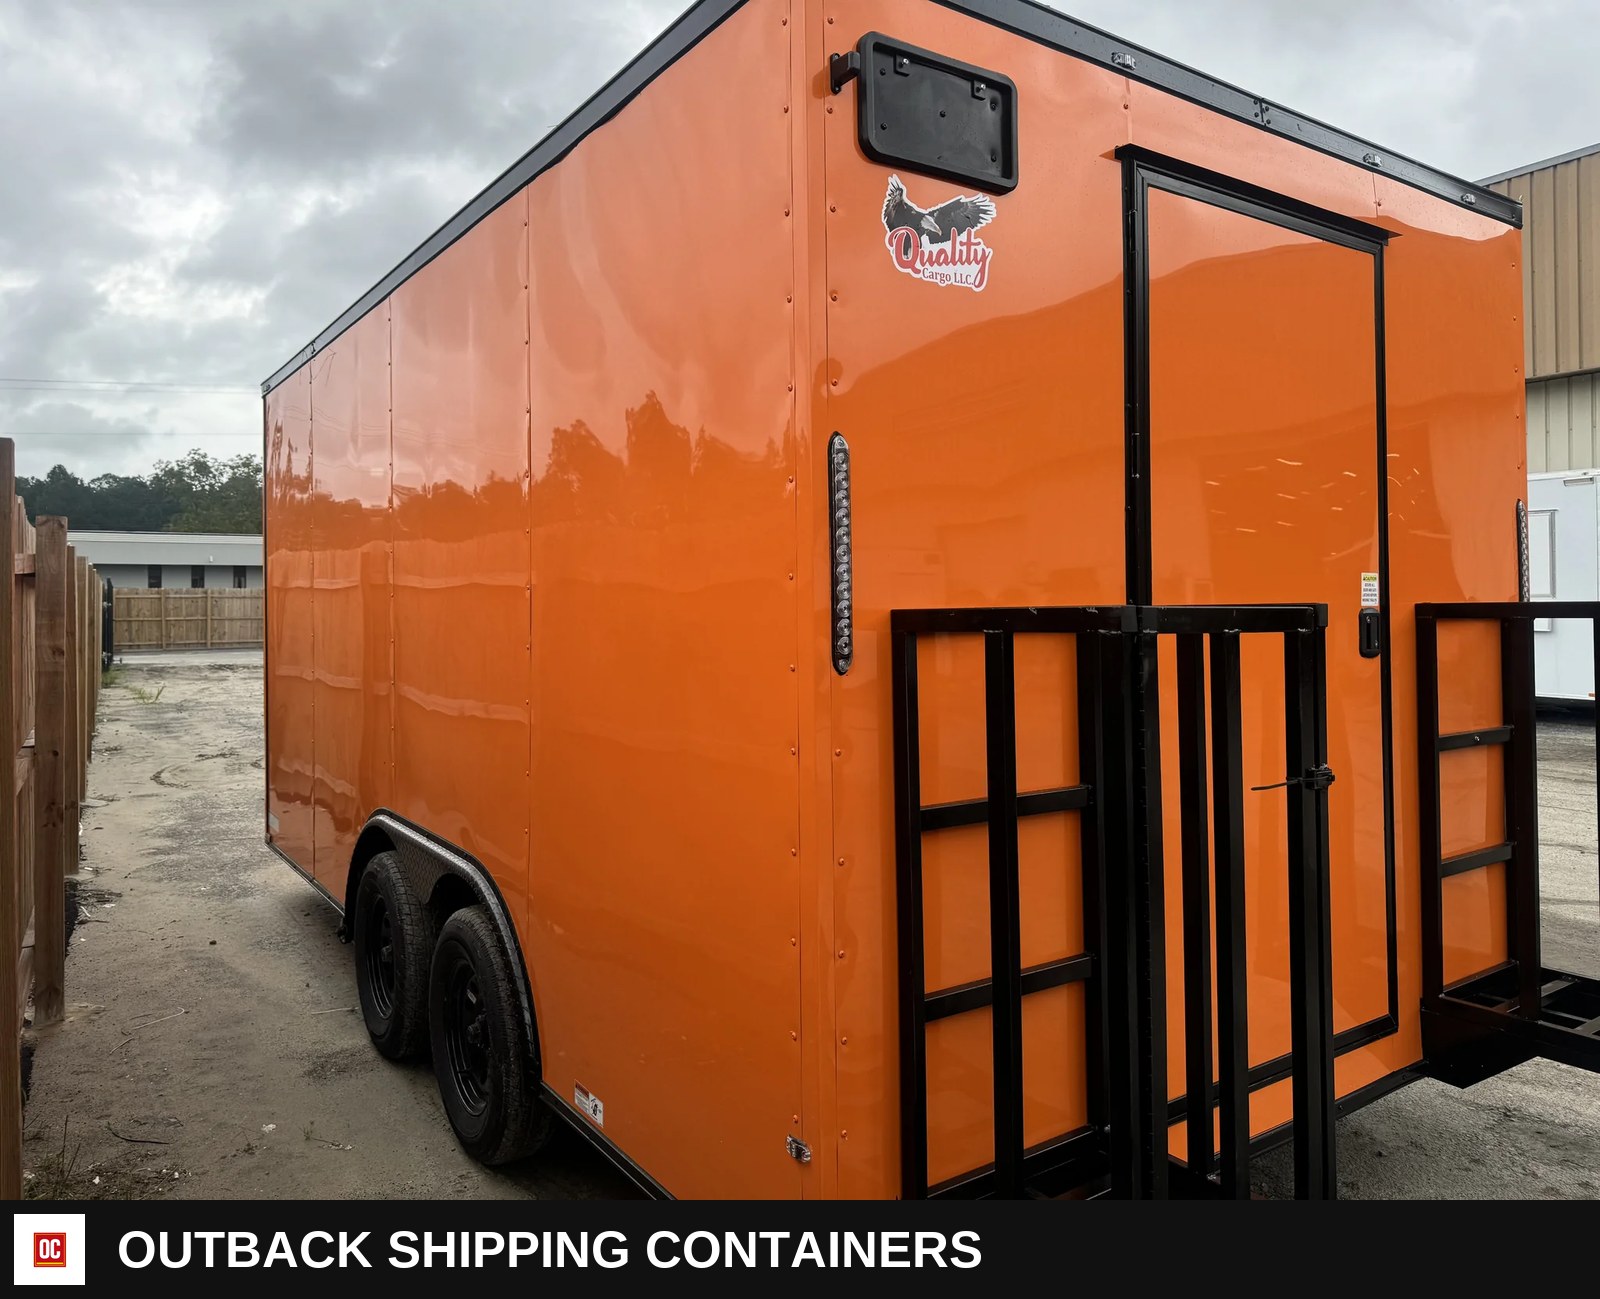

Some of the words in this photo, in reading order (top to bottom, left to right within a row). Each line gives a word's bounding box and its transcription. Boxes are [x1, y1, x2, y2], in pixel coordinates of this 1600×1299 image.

[888, 227, 991, 288] Quality
[922, 267, 951, 284] Cargo
[954, 272, 974, 286] LLC.
